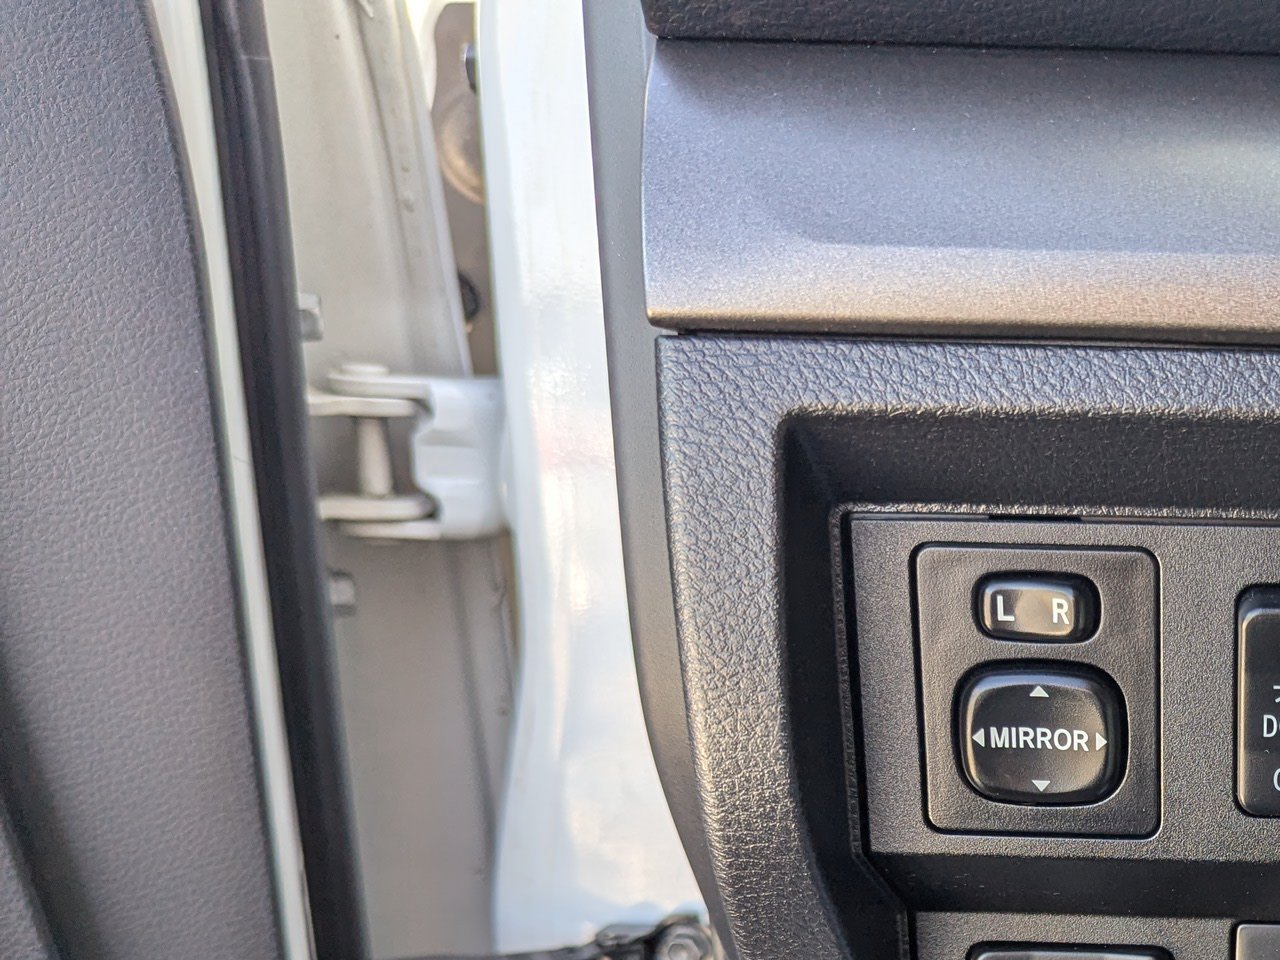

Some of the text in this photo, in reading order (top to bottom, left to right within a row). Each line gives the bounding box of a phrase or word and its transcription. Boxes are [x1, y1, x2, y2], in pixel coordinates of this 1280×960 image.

[995, 594, 1070, 625] L R
[989, 726, 1090, 752] MIRROR
